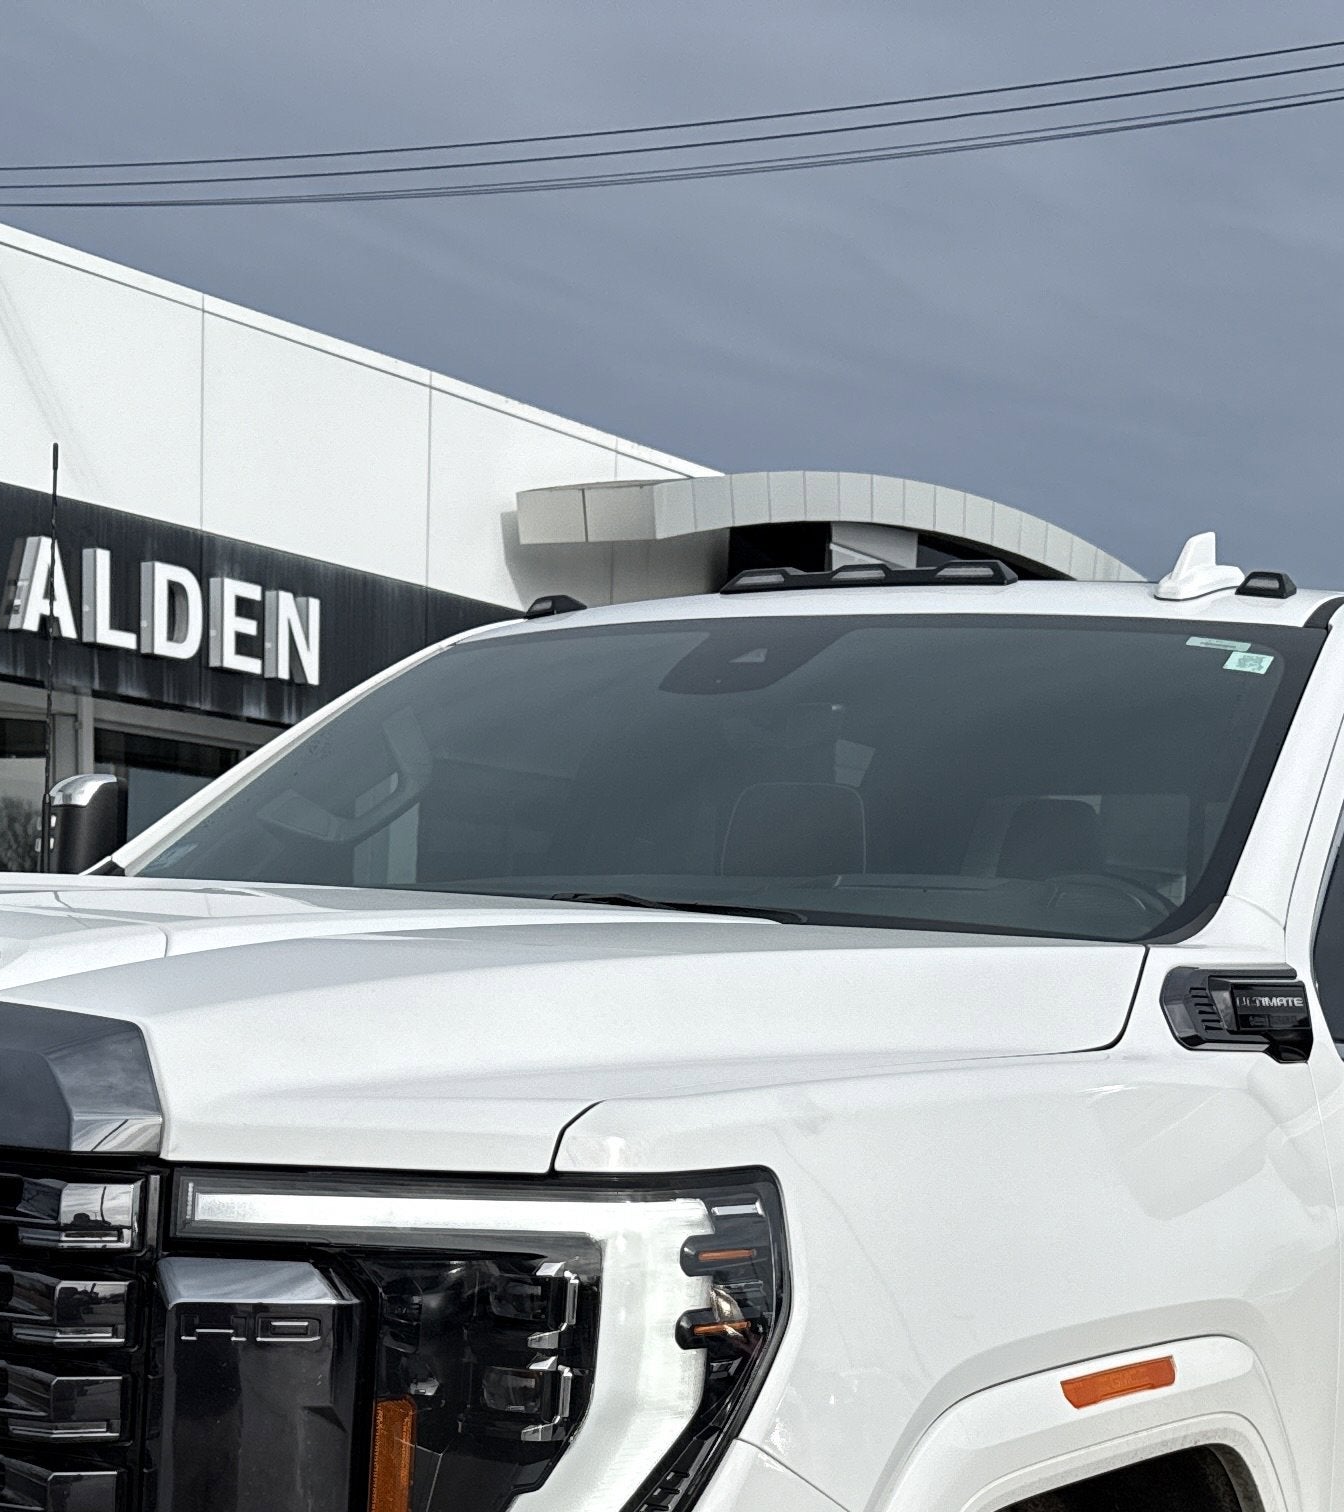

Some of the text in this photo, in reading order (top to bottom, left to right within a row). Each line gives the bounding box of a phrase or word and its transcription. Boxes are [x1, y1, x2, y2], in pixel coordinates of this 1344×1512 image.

[9, 535, 321, 687] ALDEN
[1236, 996, 1305, 1008] ULTIMATE
[180, 1313, 322, 1343] HD
